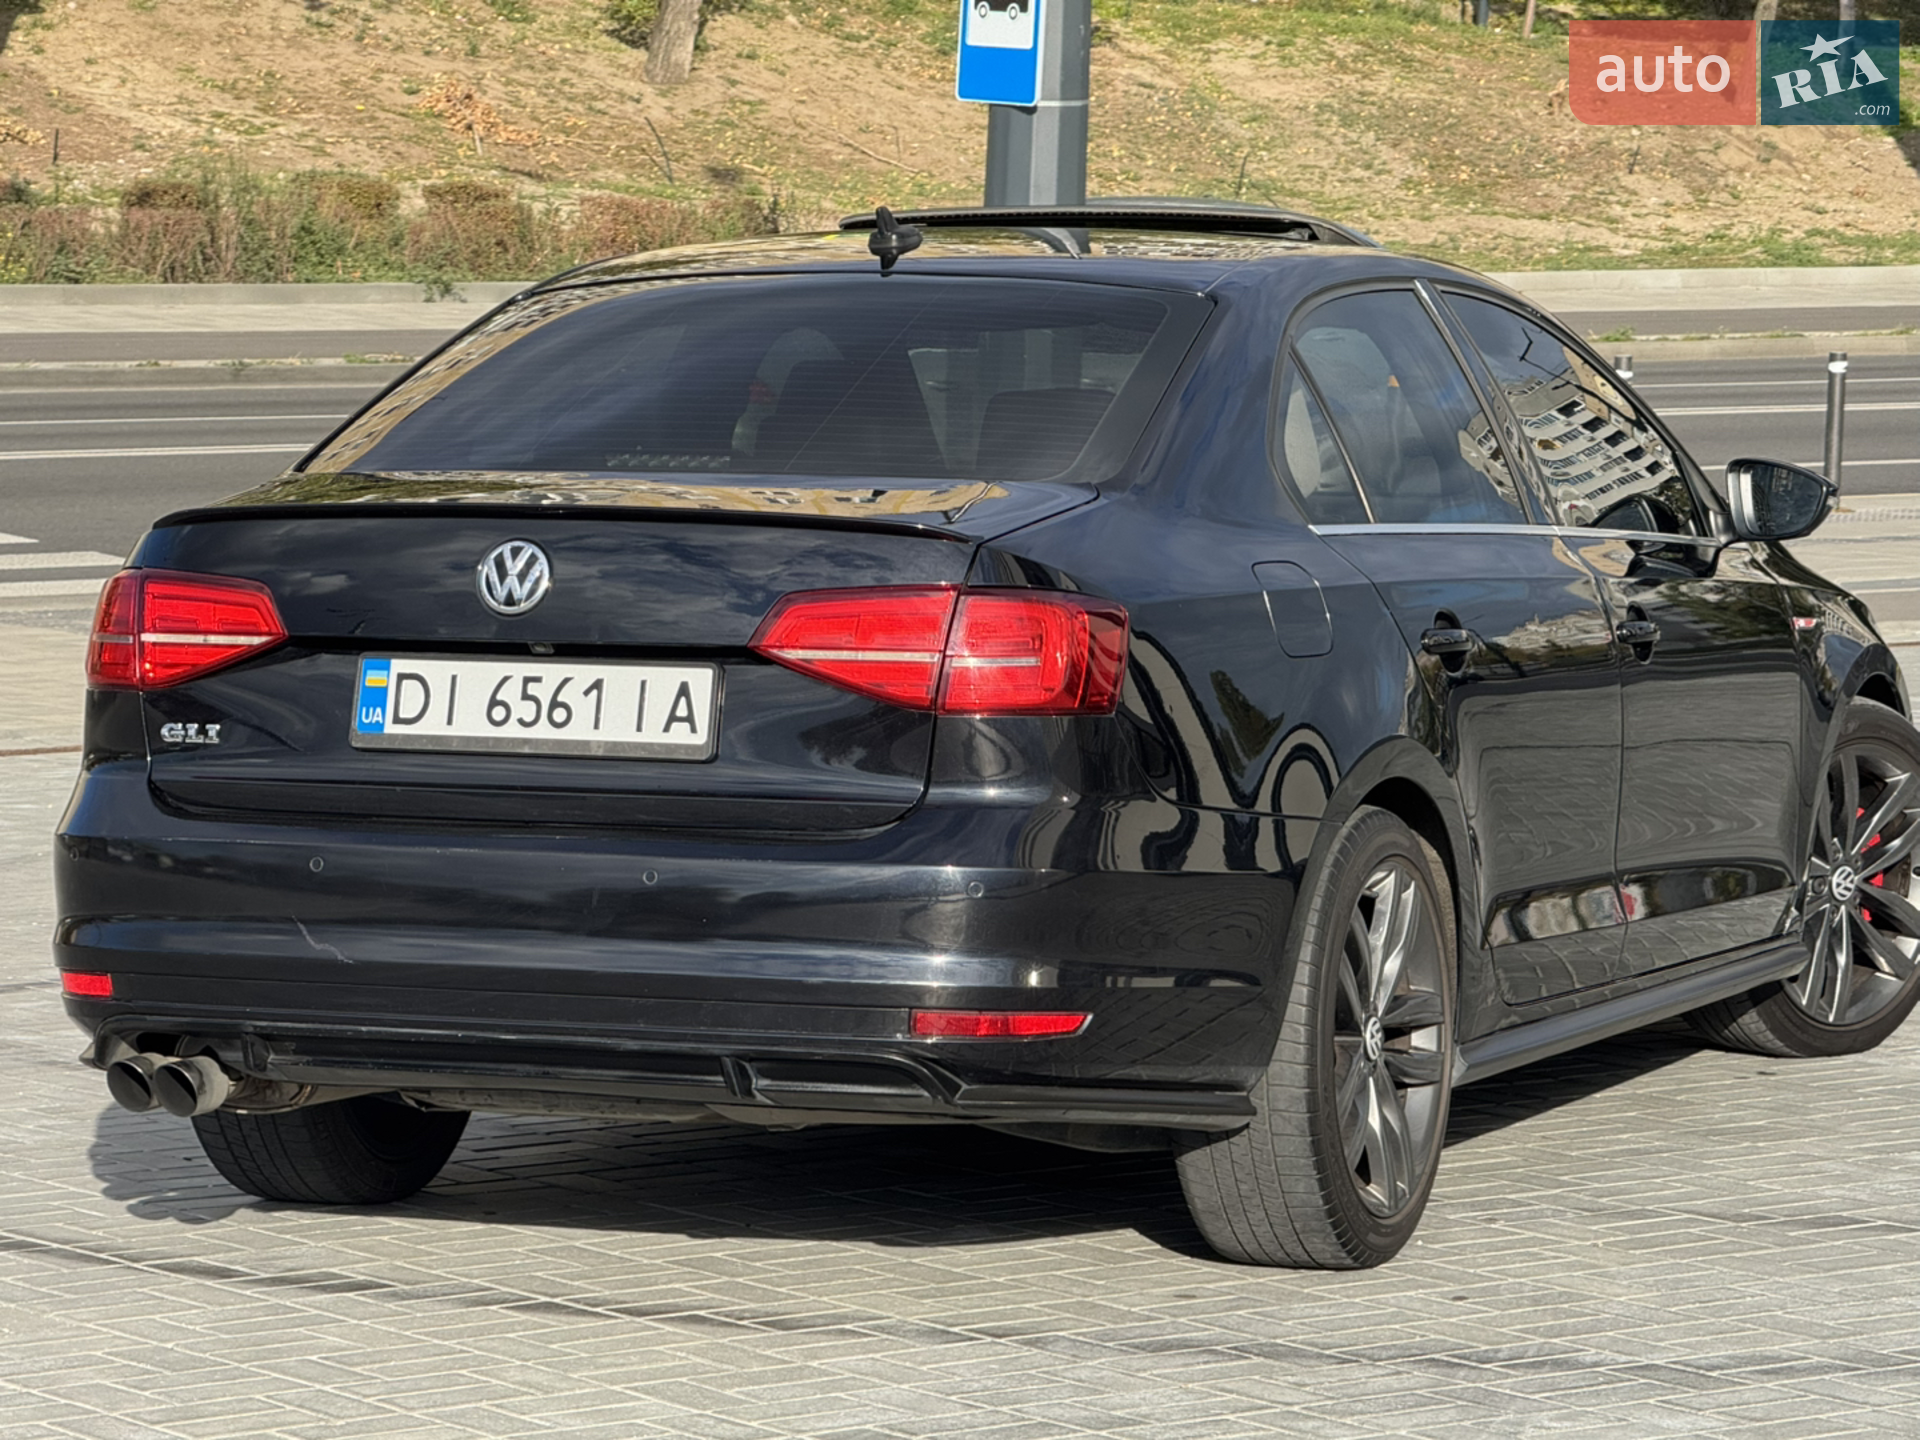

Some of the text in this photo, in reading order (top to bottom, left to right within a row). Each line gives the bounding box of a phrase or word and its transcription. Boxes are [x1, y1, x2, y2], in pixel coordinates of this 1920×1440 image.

[392, 672, 699, 734] DI 6561 IA
[361, 706, 383, 724] UA
[160, 722, 221, 743] GLI
